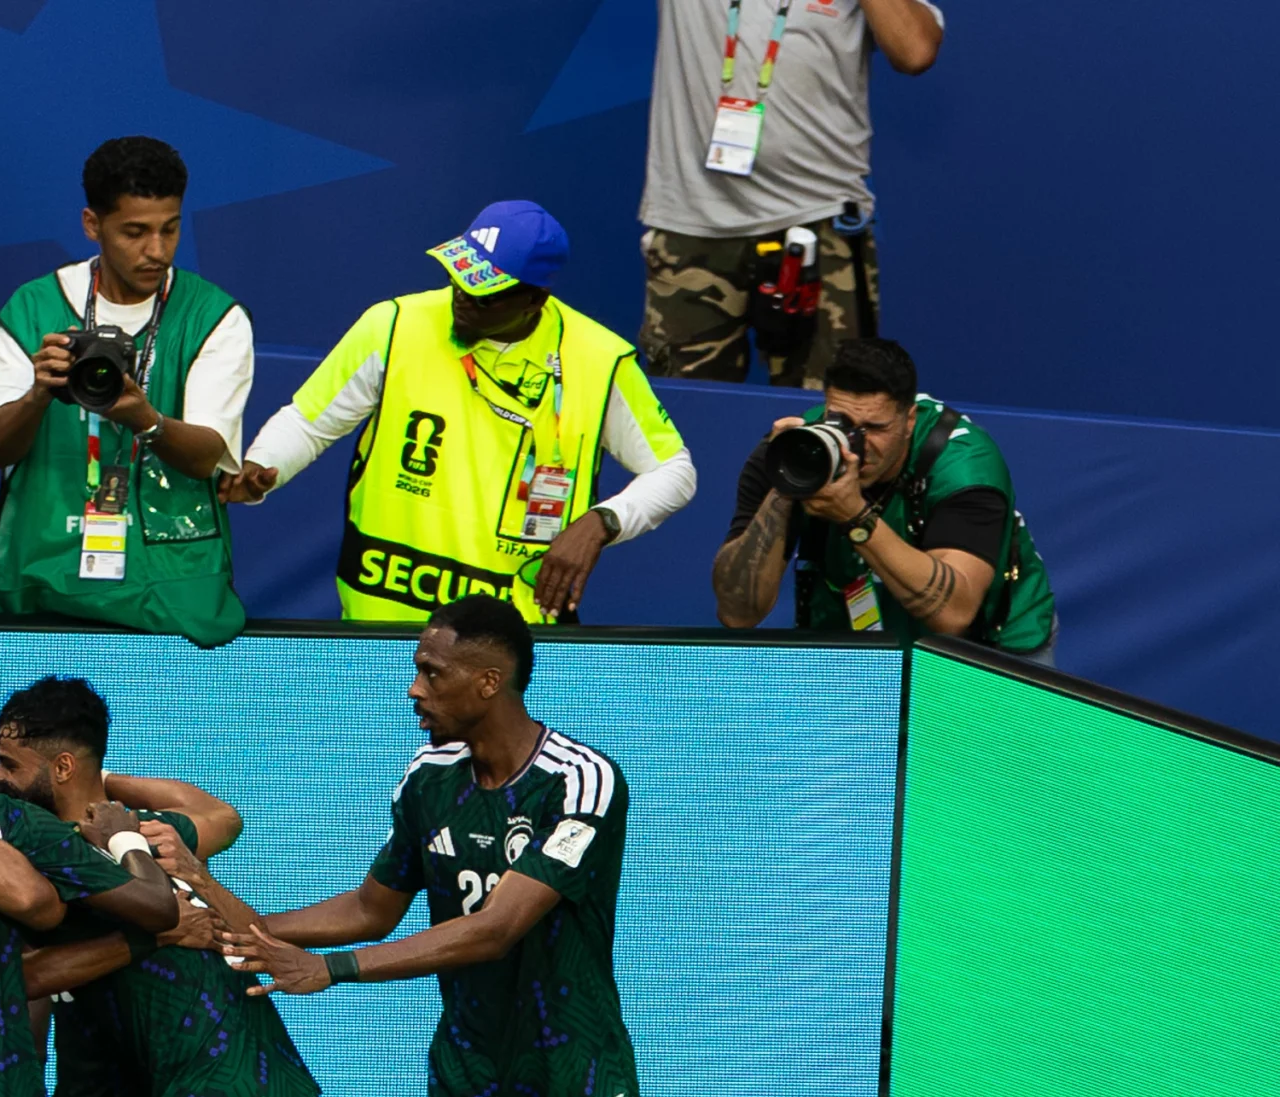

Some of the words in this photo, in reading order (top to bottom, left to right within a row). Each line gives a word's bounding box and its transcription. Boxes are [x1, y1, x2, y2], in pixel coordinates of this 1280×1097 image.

[408, 459, 426, 472] FIFA
[395, 480, 431, 498] 2026
[458, 869, 500, 916] 2
